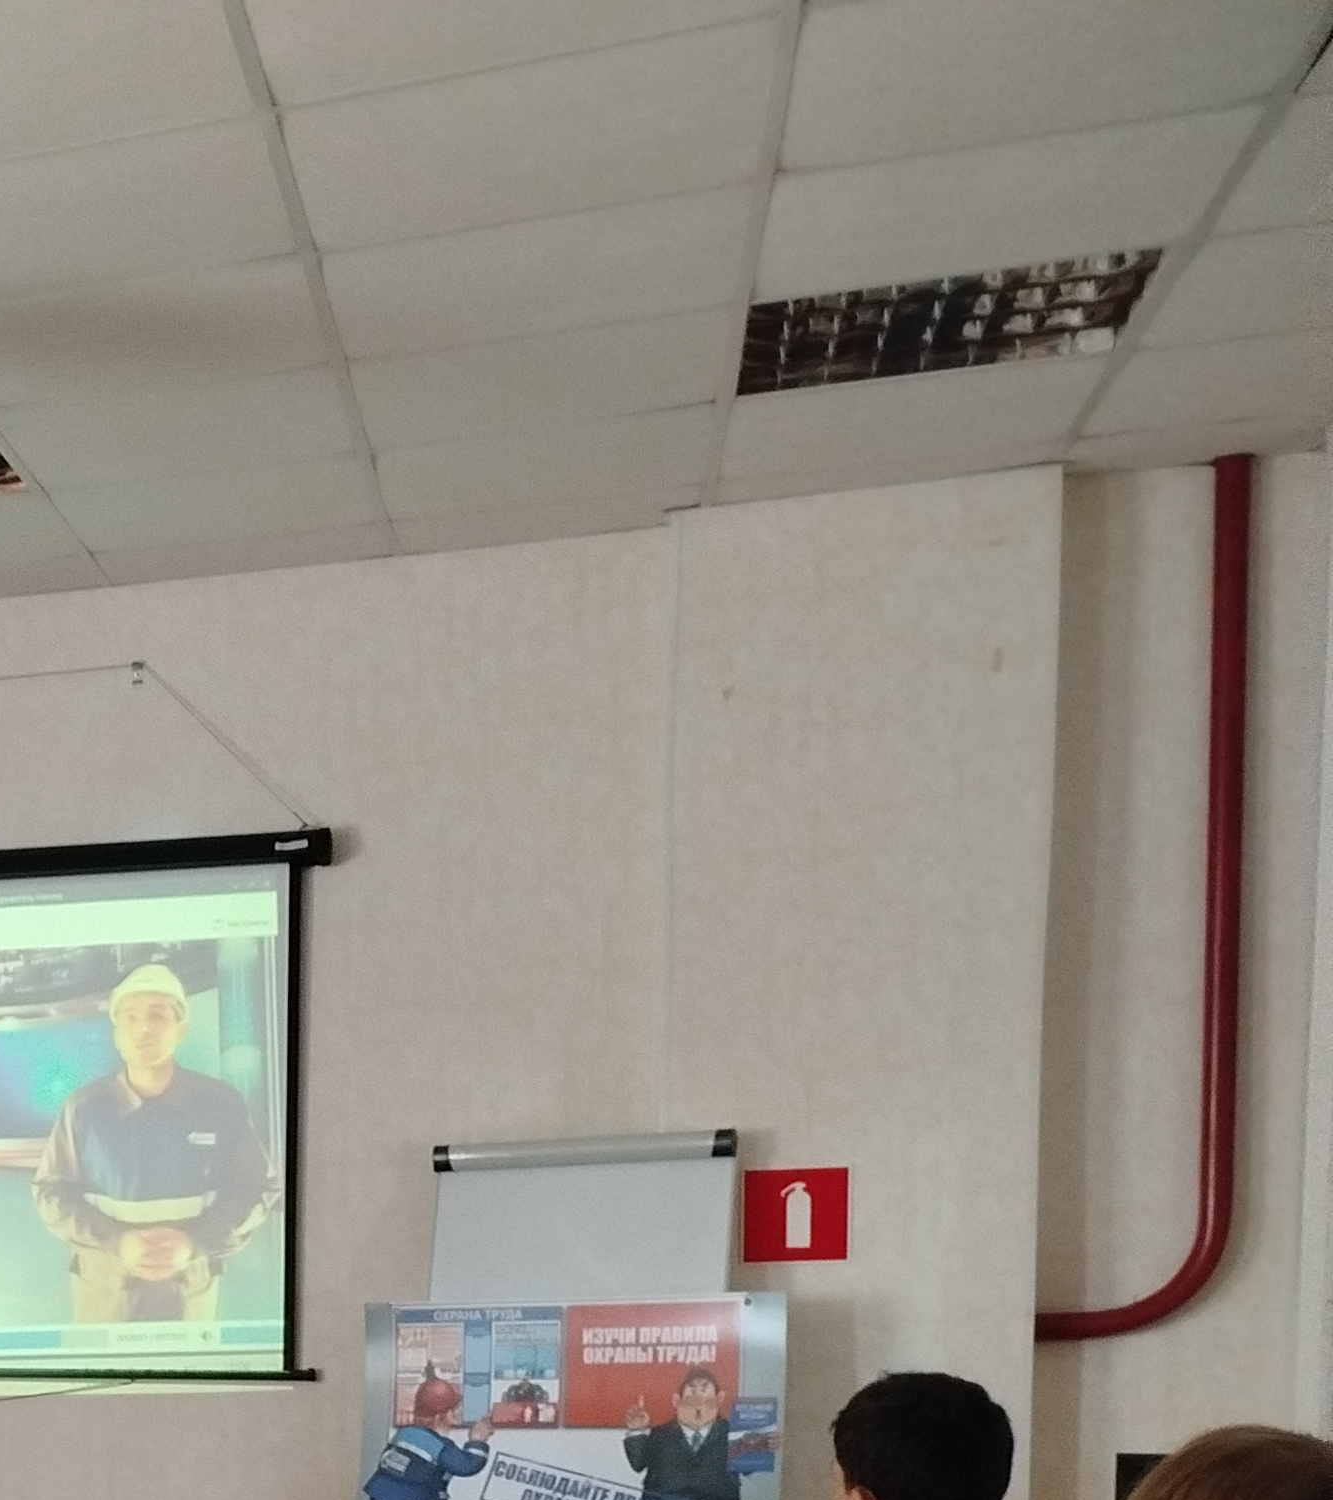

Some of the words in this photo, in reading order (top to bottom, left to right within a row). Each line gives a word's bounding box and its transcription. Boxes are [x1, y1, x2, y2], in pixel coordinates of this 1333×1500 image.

[433, 1309, 482, 1321] ОХРАНА
[483, 1308, 524, 1321] ТРУДА
[583, 1327, 636, 1345] ИЗУЧИ
[639, 1325, 719, 1344] ПРАВИЛА
[583, 1345, 653, 1364] ОХРАНЫ
[658, 1344, 717, 1365] ТРУДА!
